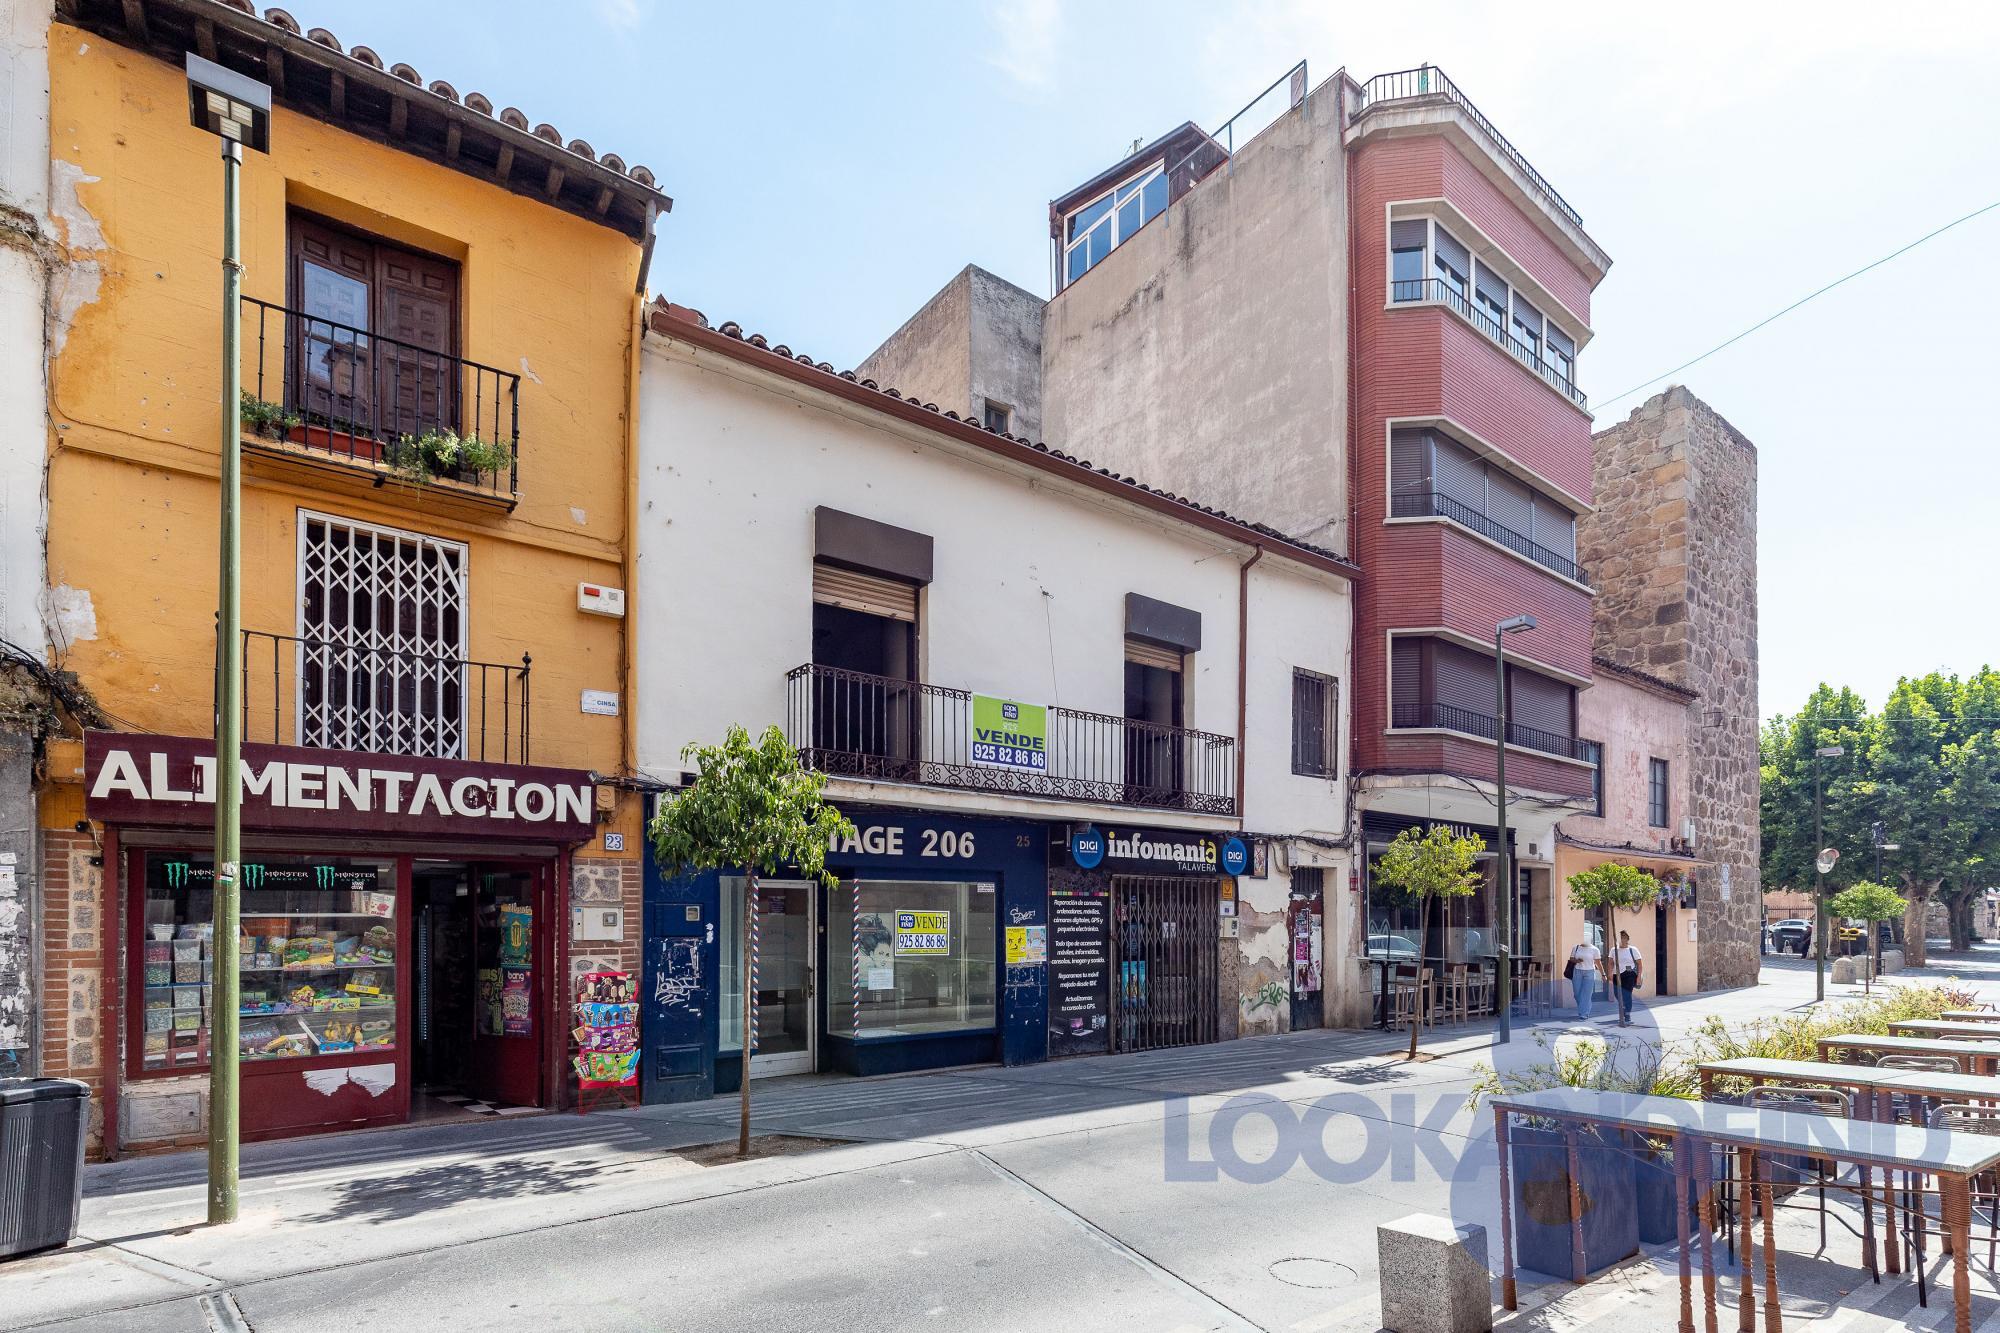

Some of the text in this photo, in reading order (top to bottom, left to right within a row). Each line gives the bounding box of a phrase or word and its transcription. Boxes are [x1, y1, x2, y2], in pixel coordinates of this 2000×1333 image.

[976, 728, 1044, 750] VENDE
[974, 744, 1044, 767] 925 82 86 86
[90, 750, 592, 824] ALIMENTACION
[606, 836, 622, 849] 23
[921, 829, 975, 858] 206
[1017, 835, 1030, 848] 25
[1079, 840, 1098, 850] DIGI
[1107, 831, 1217, 864] infomania
[1227, 851, 1243, 861] DIGI
[1177, 861, 1217, 873] TALAVERA
[264, 870, 309, 878] MONSTER
[334, 871, 376, 879] MONSTER
[916, 916, 947, 929] VENDE
[899, 934, 946, 948] 925 82 86 86
